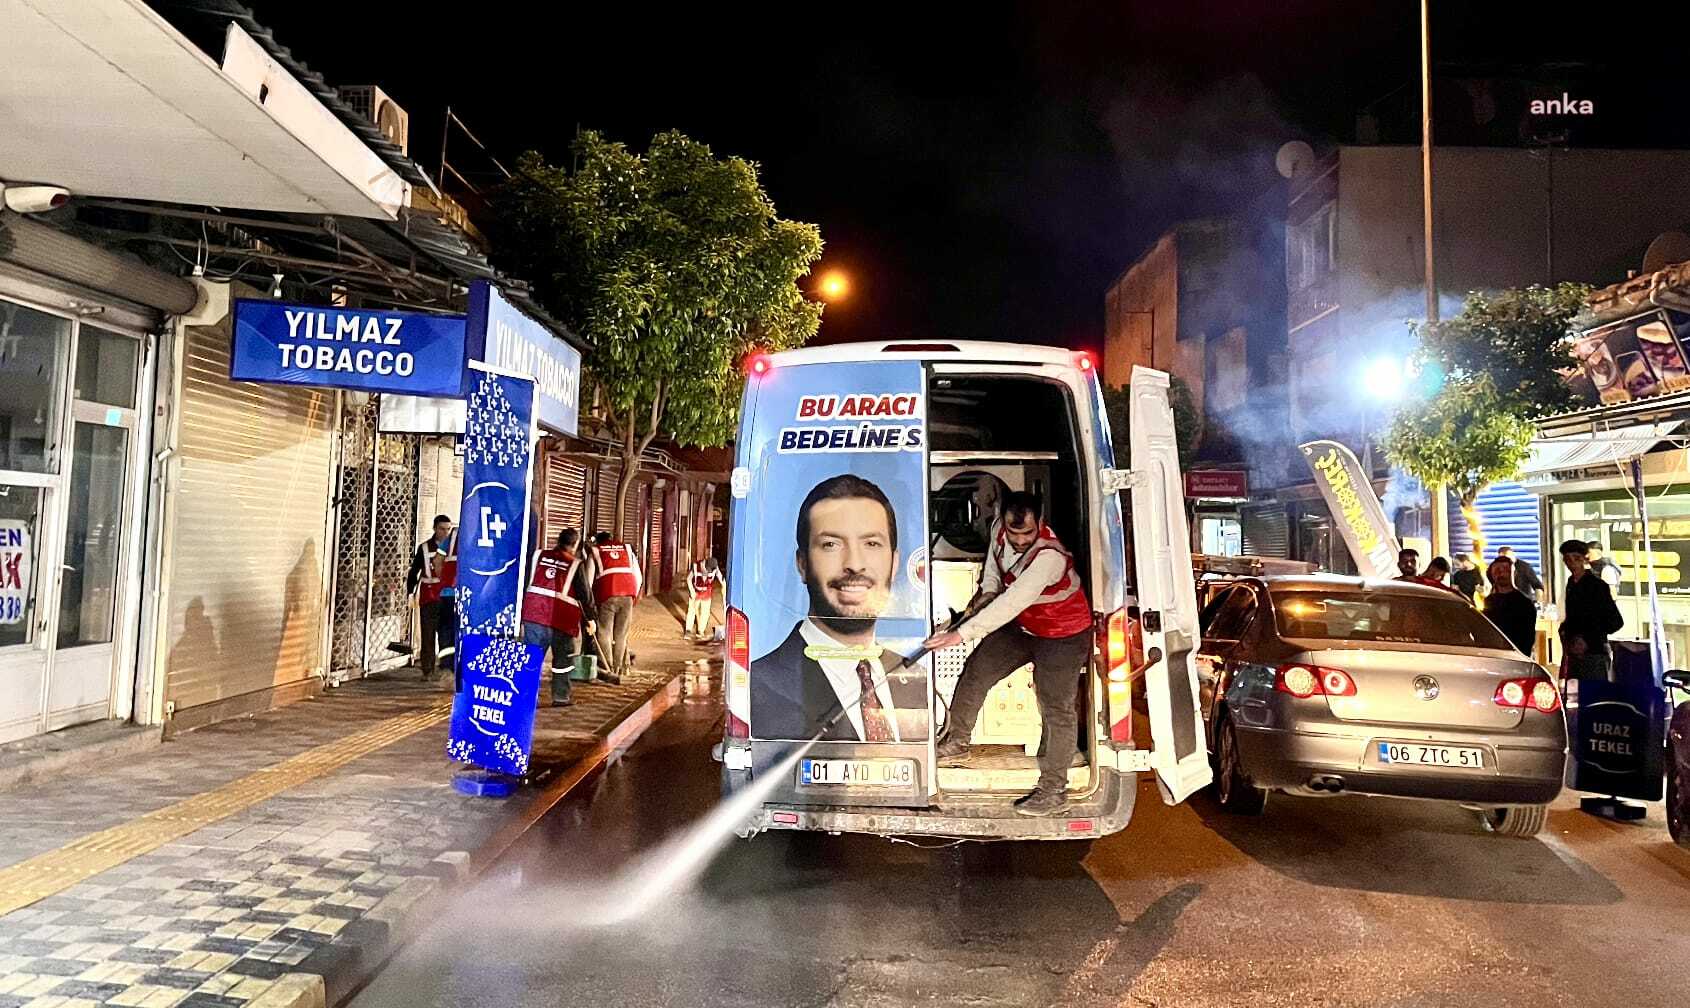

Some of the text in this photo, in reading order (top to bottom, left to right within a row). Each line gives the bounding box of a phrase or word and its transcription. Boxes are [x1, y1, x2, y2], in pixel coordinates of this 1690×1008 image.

[284, 310, 403, 345] YILMAZ
[278, 343, 414, 376] TOBACCO
[496, 318, 575, 408] YILMAZ TOBACCO
[800, 397, 917, 417] BU ARACI
[781, 425, 902, 449] BEDELİNE
[472, 684, 513, 706] YILMAZ
[472, 704, 506, 725] TEKEL
[1592, 722, 1631, 738] URAZ
[1390, 746, 1478, 766] 06 ZTC 51
[1589, 738, 1633, 755] TEKEL
[812, 763, 829, 780] 01
[843, 763, 869, 781] AYD
[882, 764, 909, 782] 048
